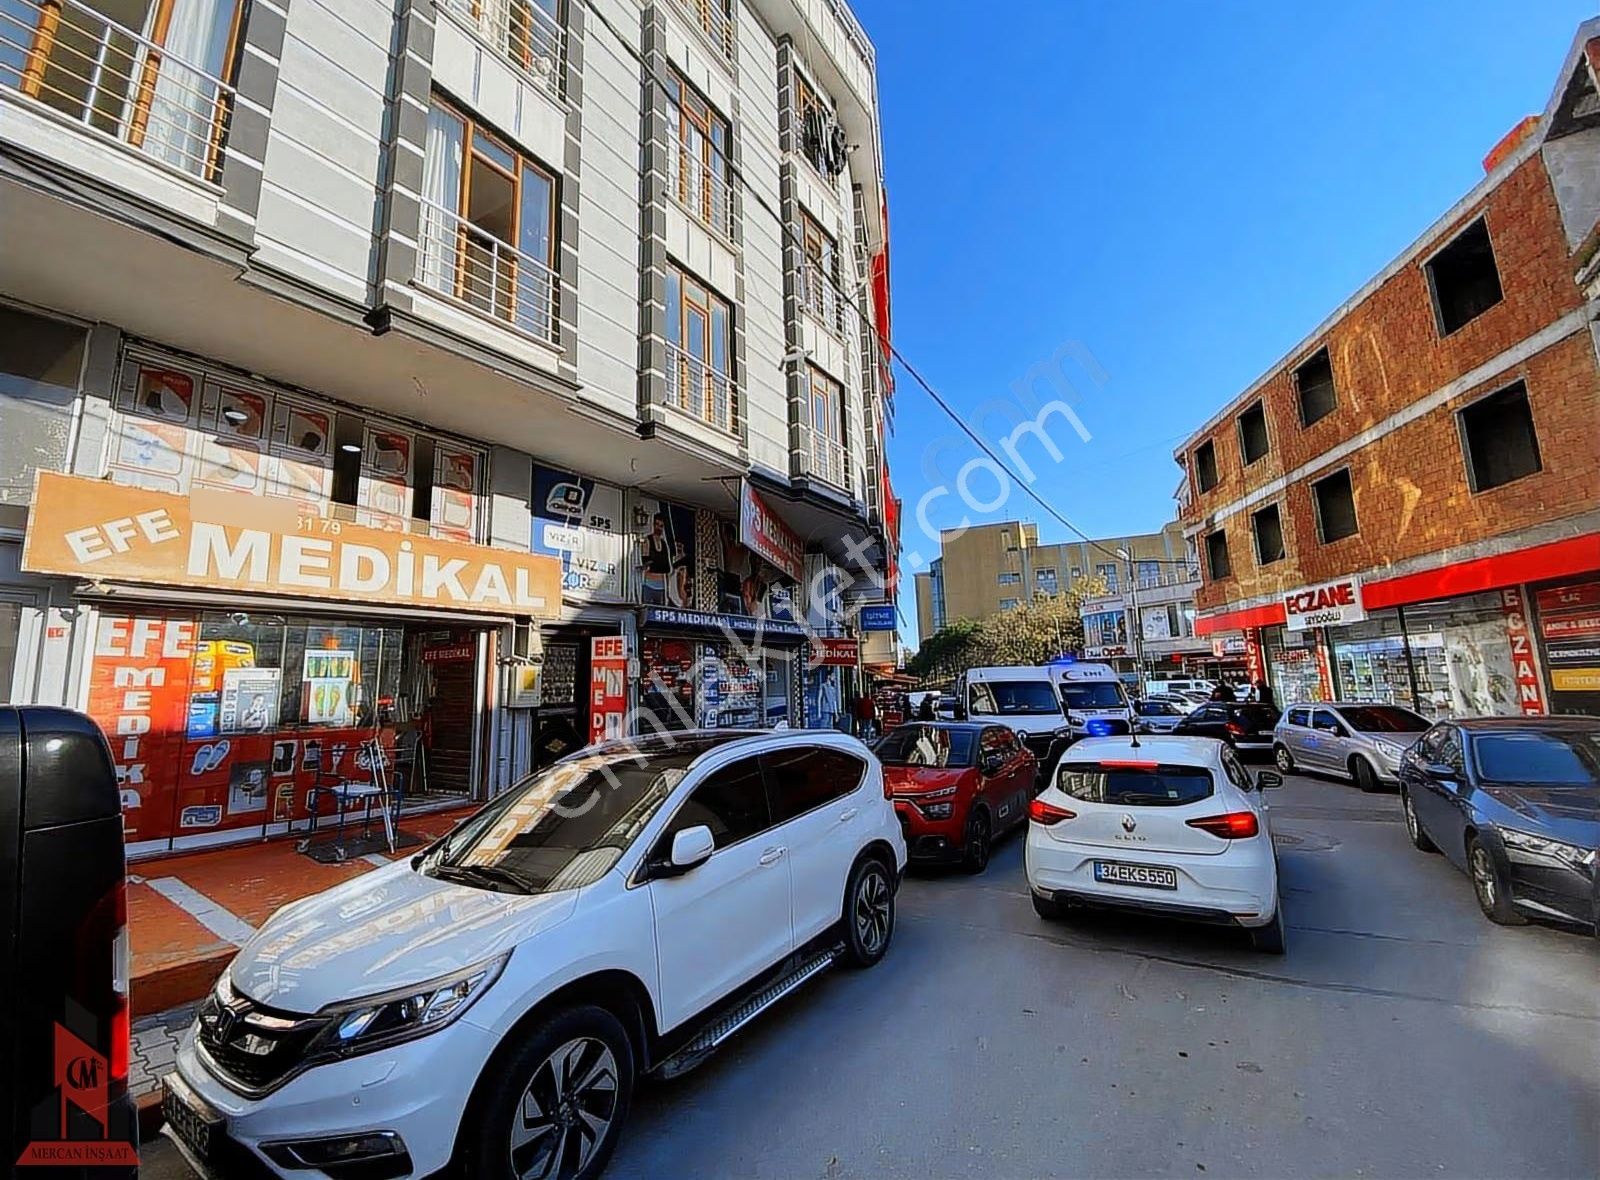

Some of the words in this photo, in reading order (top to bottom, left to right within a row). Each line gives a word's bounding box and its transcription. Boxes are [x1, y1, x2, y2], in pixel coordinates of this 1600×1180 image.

[320, 520, 341, 536] 79
[589, 516, 611, 529] SPS
[64, 508, 181, 564] EFE
[187, 521, 546, 608] MEDİKAL
[1285, 582, 1356, 615] ECZANE
[654, 610, 676, 622] SPS
[95, 617, 194, 659] EFE
[594, 640, 624, 657] EFE
